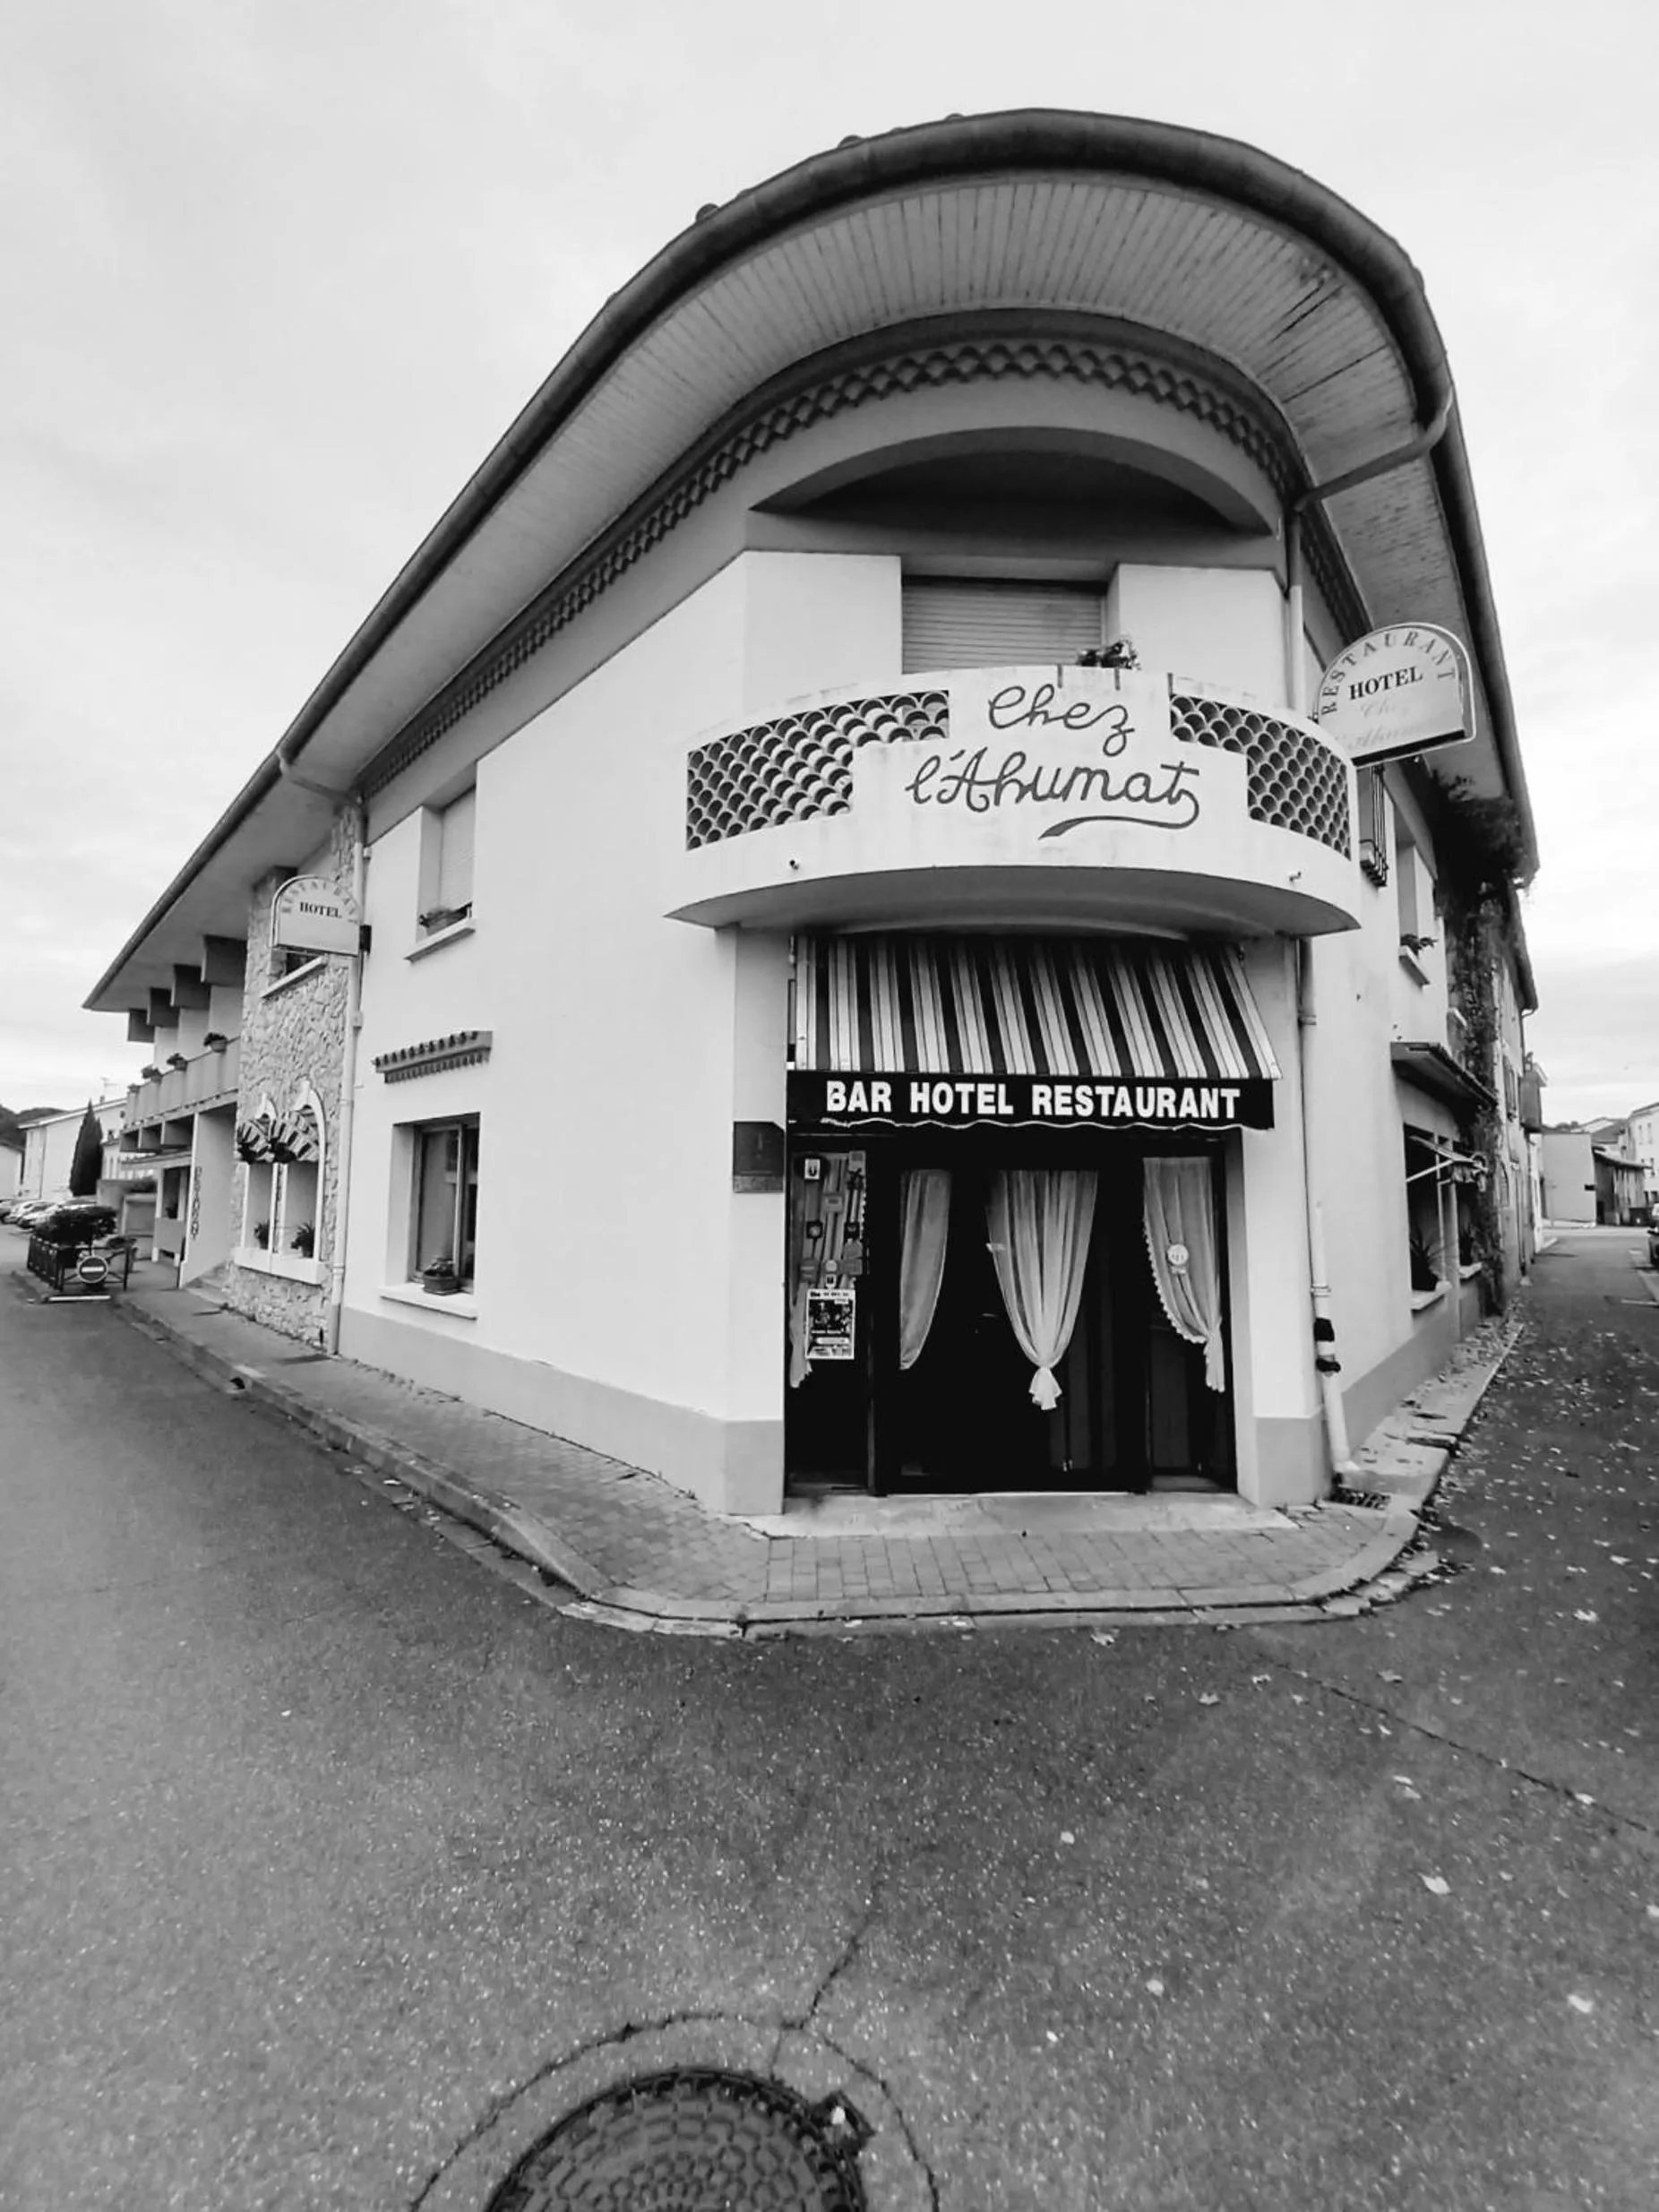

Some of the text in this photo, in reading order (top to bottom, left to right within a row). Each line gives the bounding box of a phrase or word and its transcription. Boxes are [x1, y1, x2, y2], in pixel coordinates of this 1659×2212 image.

[1321, 631, 1457, 716] RESTAURANT
[1348, 666, 1423, 701] HOTEL
[988, 684, 1135, 757] Chez
[299, 901, 342, 919] HOTEL
[826, 1080, 1240, 1119] BAR HOTEL RESTAURANT
